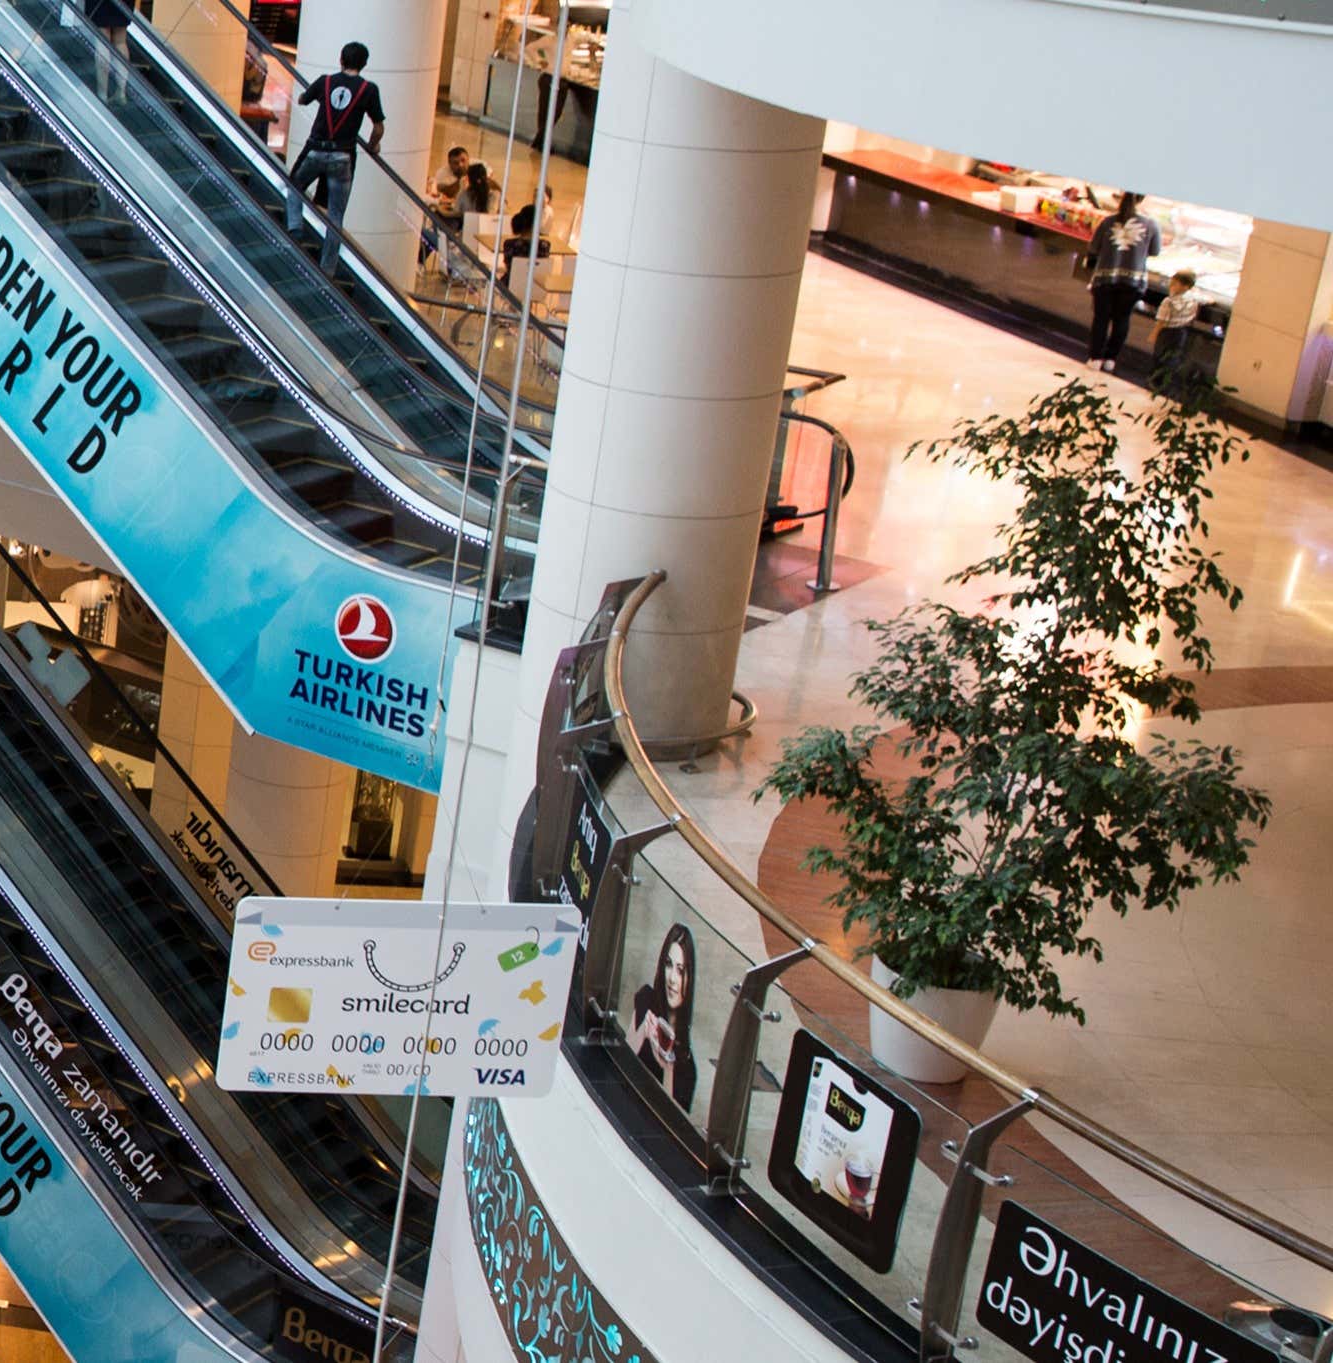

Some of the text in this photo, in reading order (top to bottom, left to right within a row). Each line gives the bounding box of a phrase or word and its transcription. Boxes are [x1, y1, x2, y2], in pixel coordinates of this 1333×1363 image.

[45, 308, 142, 437] YOUR
[295, 648, 429, 711] TURKISH
[289, 678, 425, 738] AIRLINES
[270, 954, 355, 969] expressbank
[511, 949, 526, 963] 12
[342, 993, 471, 1015] smilecard
[260, 1032, 315, 1052] 0000
[331, 1034, 386, 1054] 0000
[474, 1038, 529, 1057] 0000
[247, 1070, 357, 1085] EXPRESSBANK
[472, 1068, 526, 1086] VISA
[63, 1062, 163, 1184] zamanıdır
[986, 1276, 1127, 1363] dəyişd
